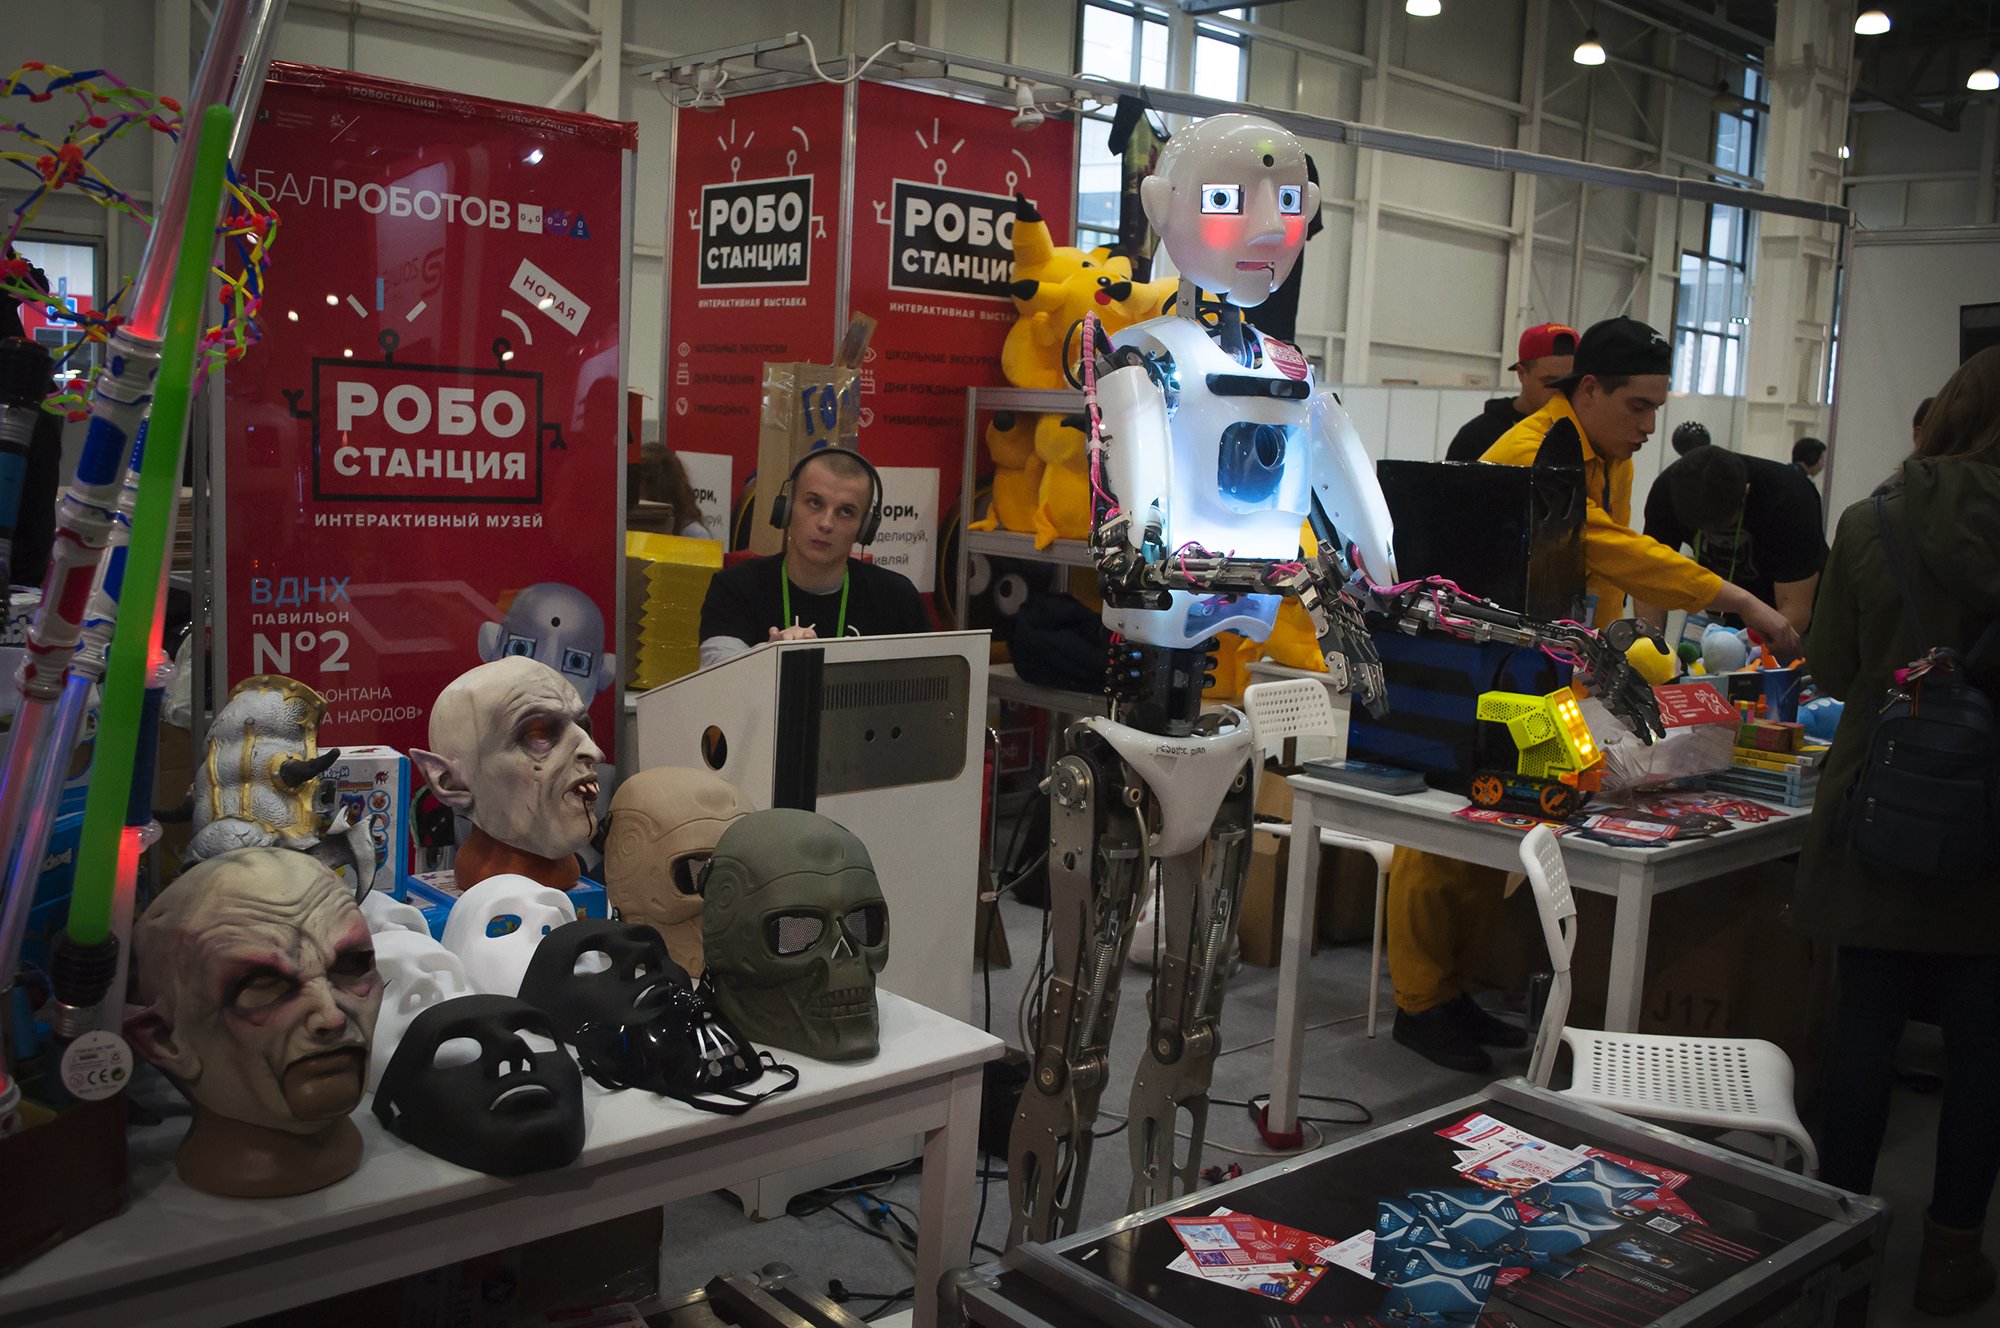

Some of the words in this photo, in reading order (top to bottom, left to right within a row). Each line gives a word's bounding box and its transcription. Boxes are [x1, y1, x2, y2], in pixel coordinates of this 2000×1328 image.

[709, 191, 804, 237] РОБО
[706, 242, 801, 271] СТАНЦИЯ
[698, 298, 760, 308] ИНТЕРАКТИВНАЯ
[764, 296, 807, 307] ВЫСТАВКА
[889, 302, 975, 319] ИНТЕРАКТИВНАЯ
[885, 350, 946, 364] ШКОЛЬНЫЕ
[883, 382, 908, 393] ДНИ
[336, 381, 527, 439] РОБО
[333, 446, 527, 484] СТАНЦИЯ
[315, 512, 479, 528] ИНТЕРАКТИВНЫЙ
[486, 512, 543, 529] МУЗЕЙ
[251, 576, 351, 608] ВДНХ
[252, 611, 349, 626] ПАВИЛЬОН
[337, 706, 424, 724] НАРОДОВ»
